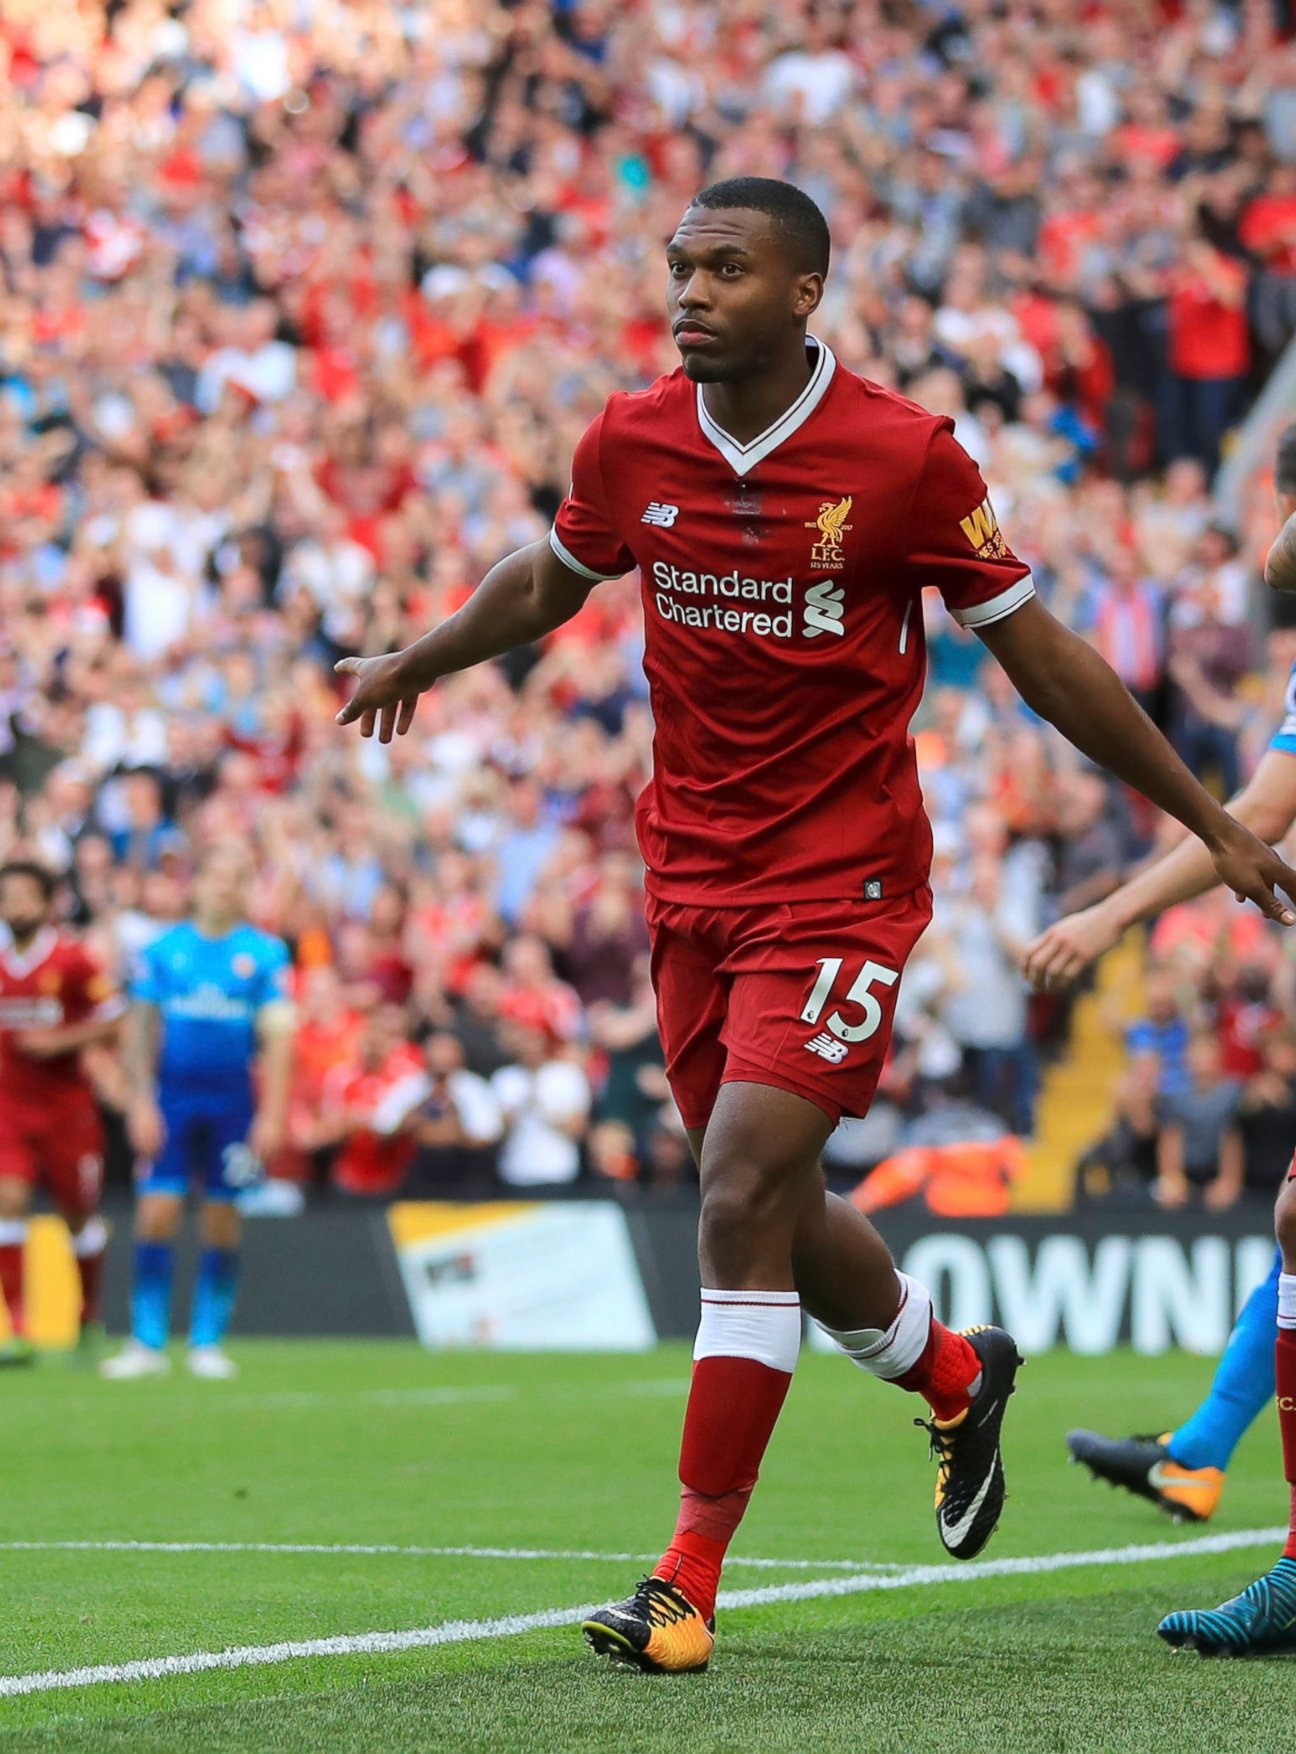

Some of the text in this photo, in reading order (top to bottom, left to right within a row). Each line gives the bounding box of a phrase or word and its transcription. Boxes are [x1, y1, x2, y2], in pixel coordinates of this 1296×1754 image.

[810, 547, 845, 562] L.F.C.
[822, 562, 844, 570] YEARS
[652, 561, 793, 604] Standard
[655, 592, 793, 638] Chartered
[799, 957, 900, 1042] 15
